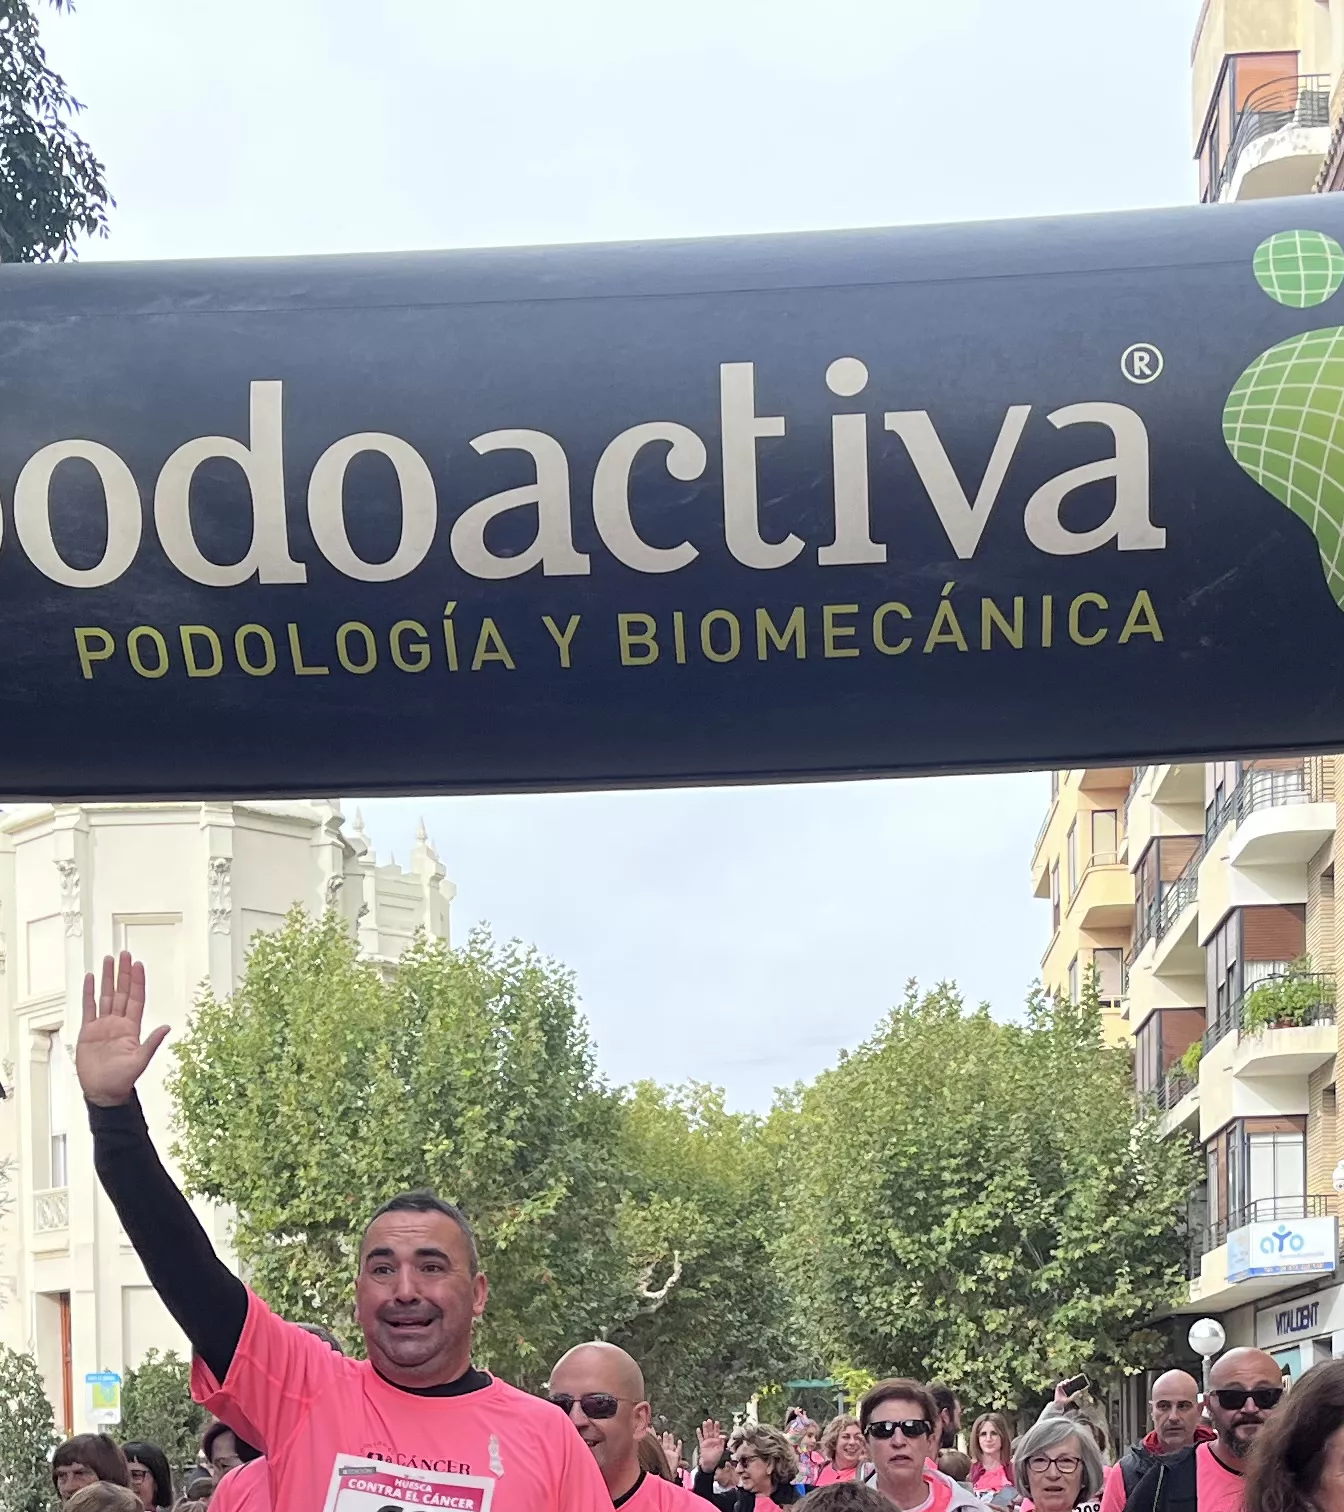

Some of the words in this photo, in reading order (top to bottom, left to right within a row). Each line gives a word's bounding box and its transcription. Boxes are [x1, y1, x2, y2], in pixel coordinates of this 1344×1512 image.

[77, 601, 517, 681] PODOLOGÍA
[543, 611, 581, 668] Y
[616, 585, 1166, 668] BIOMECÁNICA
[347, 1478, 402, 1499] CONTRA
[405, 1491, 420, 1503] EL
[422, 1492, 475, 1510] CÁNCER
[394, 1477, 433, 1493] HUESCA
